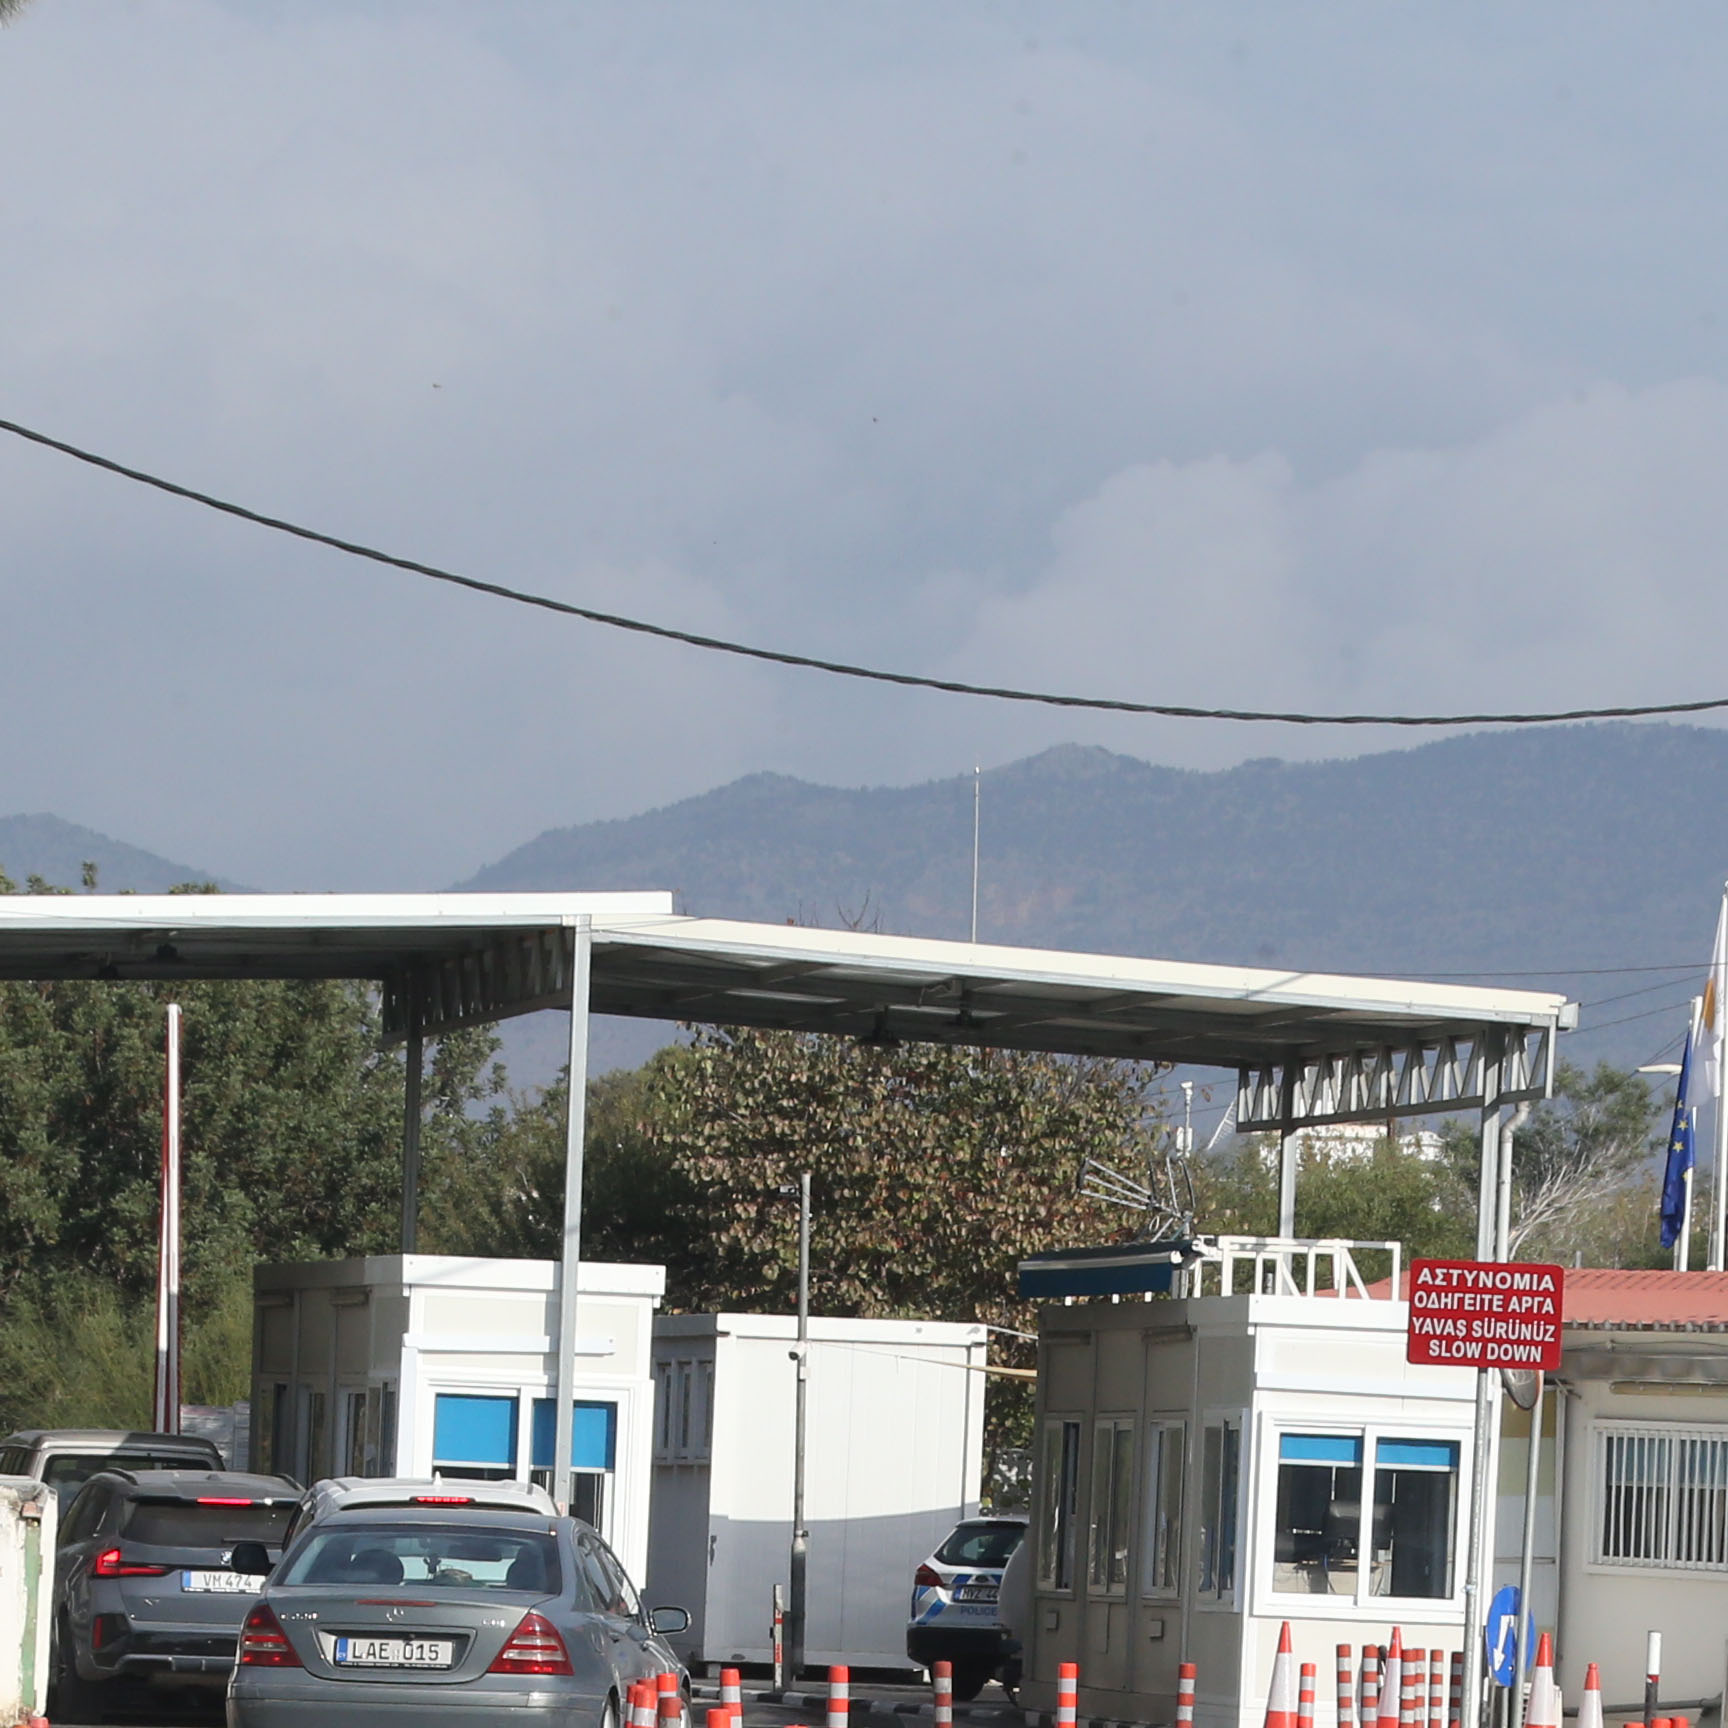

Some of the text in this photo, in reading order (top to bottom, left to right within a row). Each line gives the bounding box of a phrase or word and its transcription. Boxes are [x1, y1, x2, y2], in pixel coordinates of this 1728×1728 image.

[1417, 1267, 1555, 1292] ΑΣΤΥΝΟΜΙΑ
[1414, 1291, 1555, 1314] ΟΔΗΓΕΙΤΕ ΑΡΓΑ
[1412, 1316, 1556, 1342] YAVAŞ SÜRÜNÜZ
[1428, 1340, 1542, 1362] SLOW DOWN
[204, 1574, 252, 1588] VM 474
[960, 1606, 998, 1616] POLICE
[353, 1642, 390, 1660] LAE
[403, 1642, 440, 1661] 015
